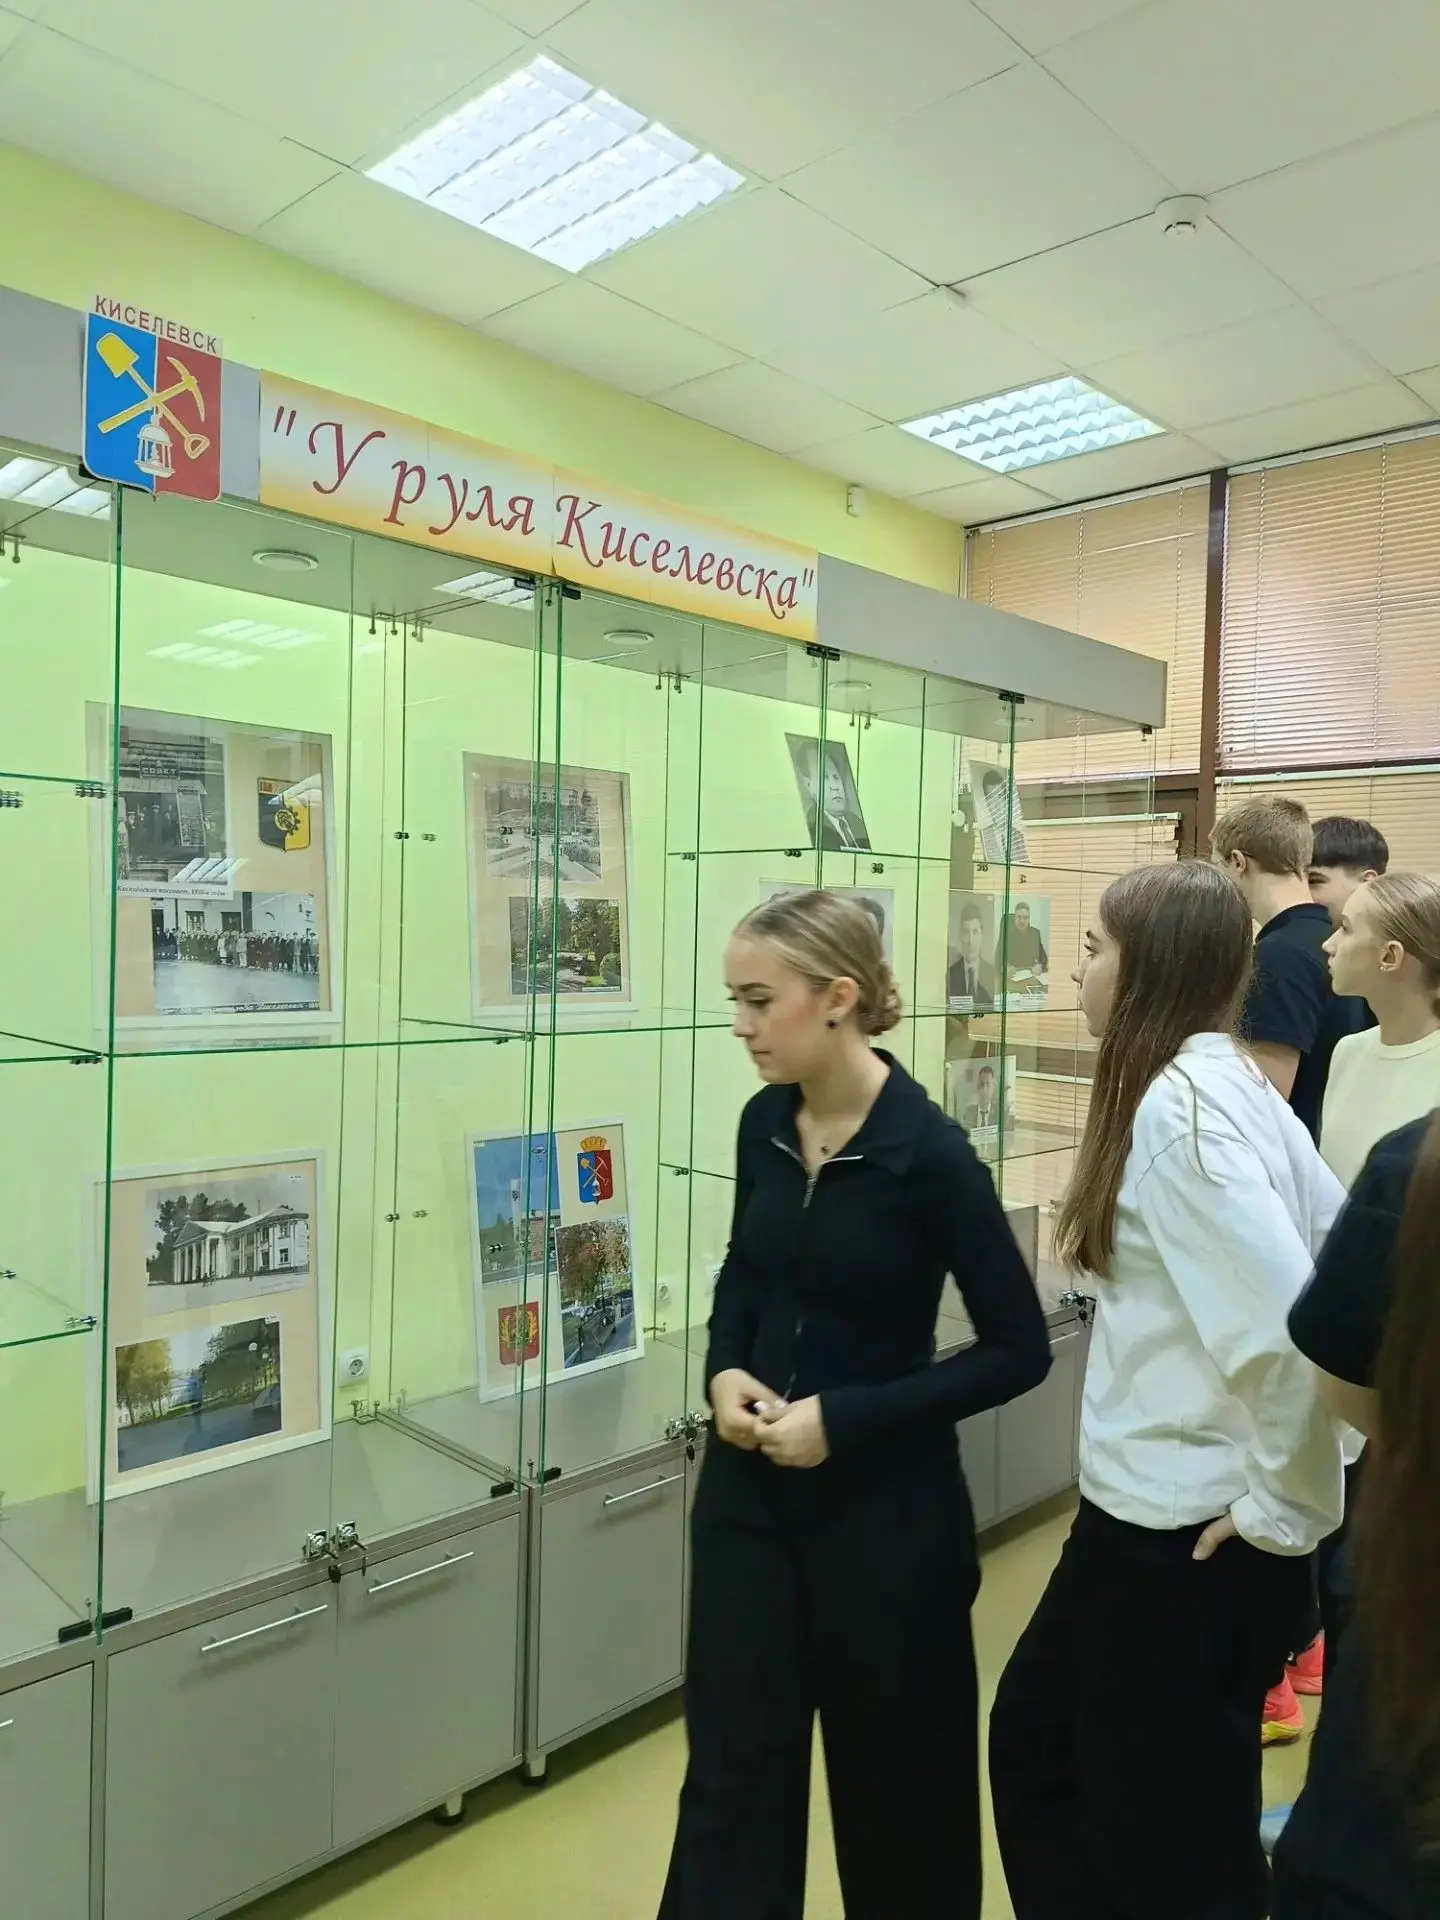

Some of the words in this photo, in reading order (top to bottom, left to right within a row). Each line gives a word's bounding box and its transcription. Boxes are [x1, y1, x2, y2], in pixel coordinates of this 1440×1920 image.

[95, 295, 217, 353] КИСЕЛЕВСК
[383, 460, 535, 536] руля
[555, 494, 815, 620] Киселевска"
